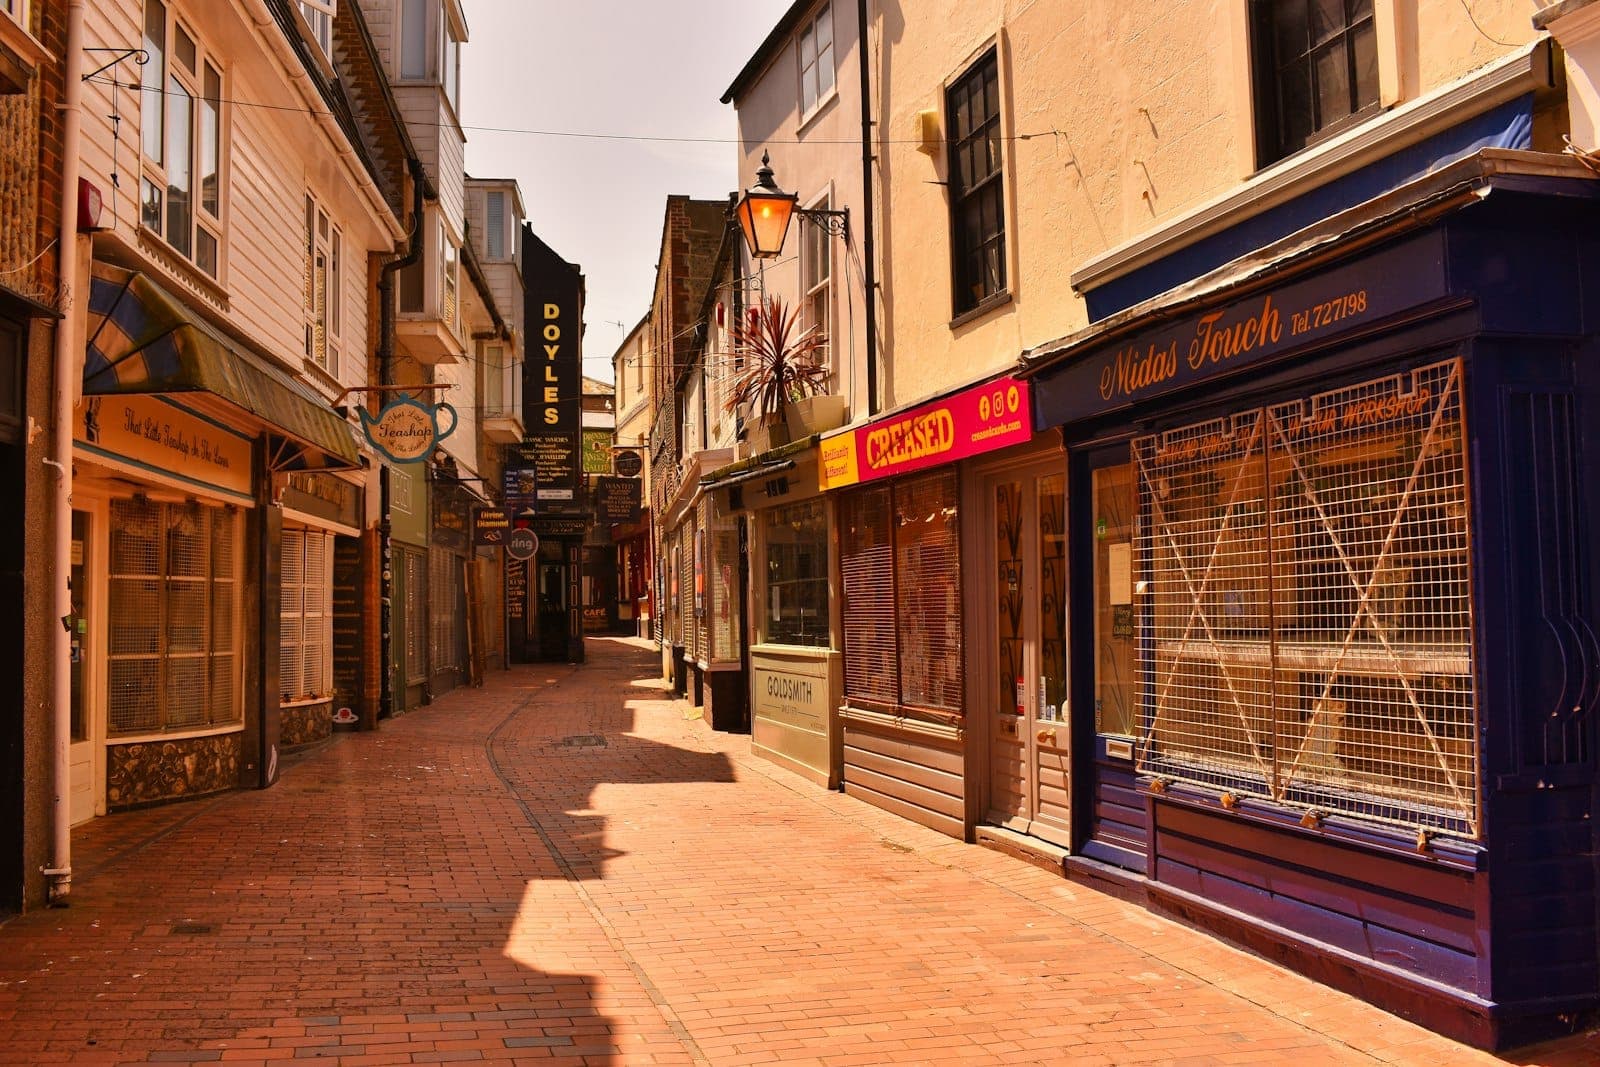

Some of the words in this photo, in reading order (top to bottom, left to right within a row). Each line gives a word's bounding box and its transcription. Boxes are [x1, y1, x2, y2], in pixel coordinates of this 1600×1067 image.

[543, 303, 561, 424] DOYLES
[1099, 340, 1178, 401] Midas
[1187, 295, 1283, 370] Touch
[1313, 290, 1368, 327] 727198
[387, 410, 405, 424] That
[407, 409, 425, 424] Little
[1342, 387, 1431, 429] WORKSHOP
[124, 407, 142, 435] That
[144, 416, 161, 443] Little
[164, 424, 190, 461] Teashop
[201, 439, 212, 462] The
[379, 423, 432, 441] Teashop
[866, 408, 955, 470] CREASED
[511, 538, 534, 550] ring
[767, 676, 812, 704] GOLDSMITH
